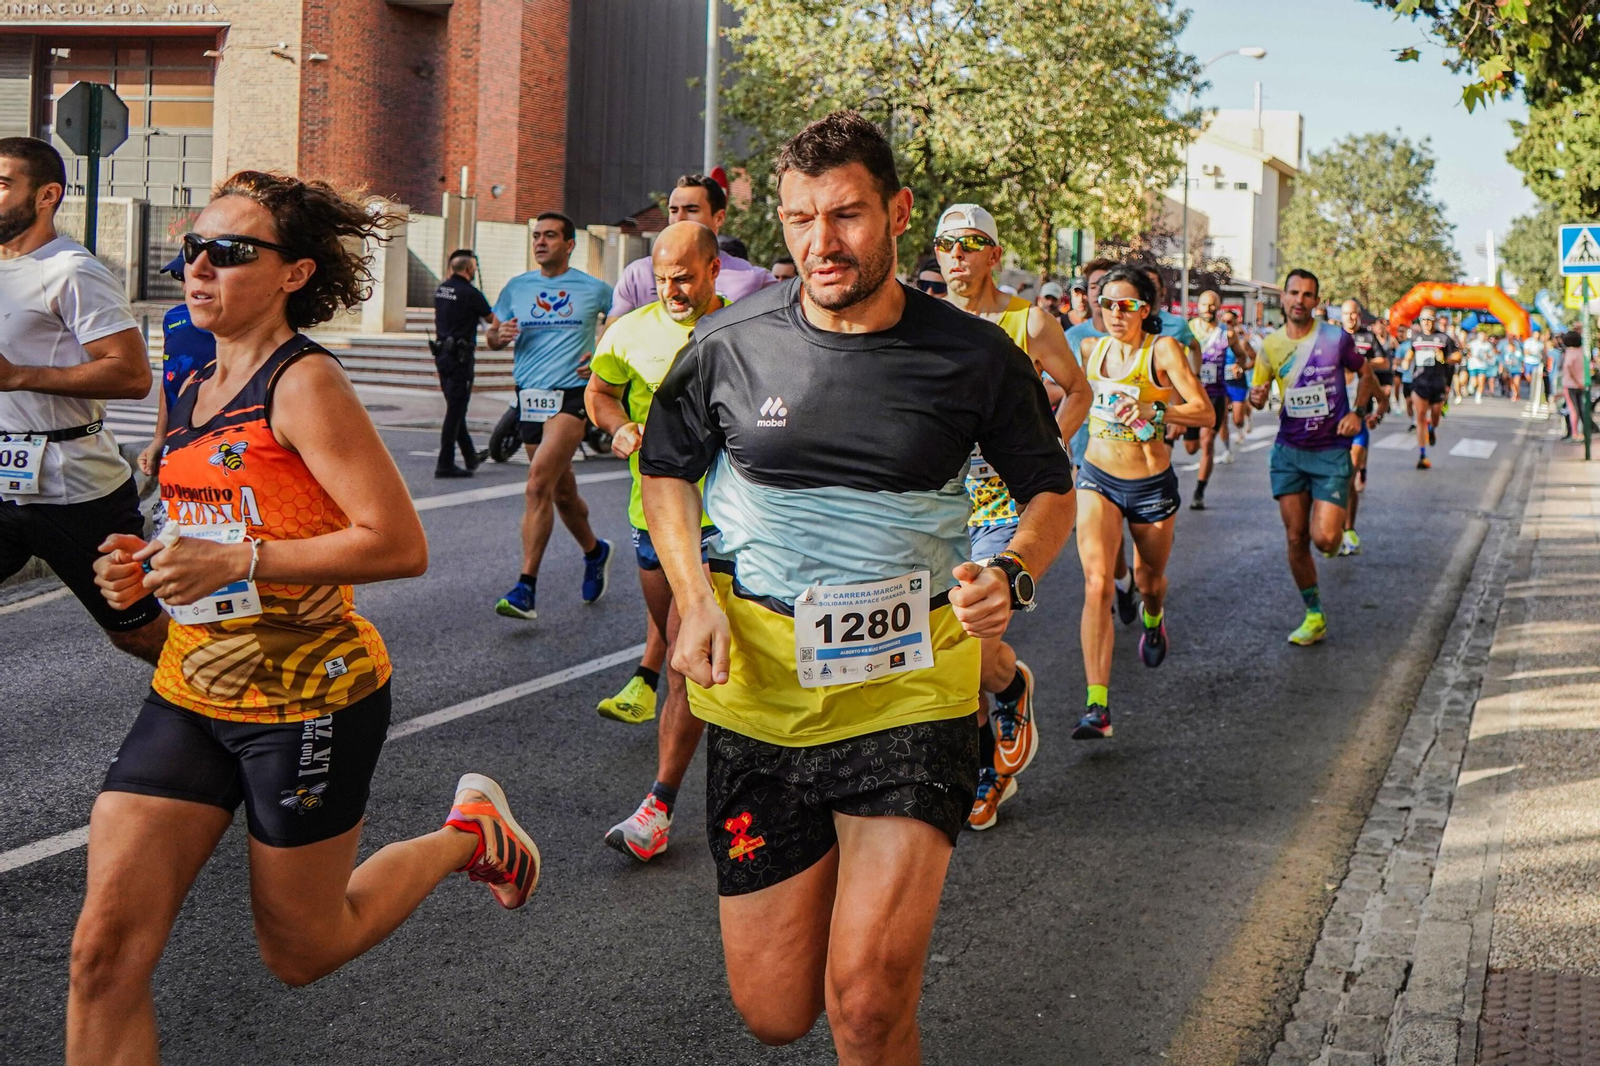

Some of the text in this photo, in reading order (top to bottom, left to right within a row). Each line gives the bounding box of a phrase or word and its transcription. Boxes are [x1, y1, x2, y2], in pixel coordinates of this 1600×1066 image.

[4, 3, 149, 15] INMACULADA
[526, 398, 556, 409] 1183
[1290, 394, 1320, 406] 1529
[757, 419, 787, 427] mobel
[0, 449, 29, 469] 08
[833, 583, 903, 599] CARRERA-MARCHA
[880, 590, 906, 602] GRANADA
[815, 602, 911, 643] 1280
[300, 743, 313, 766] Club
[298, 747, 332, 777] LA
